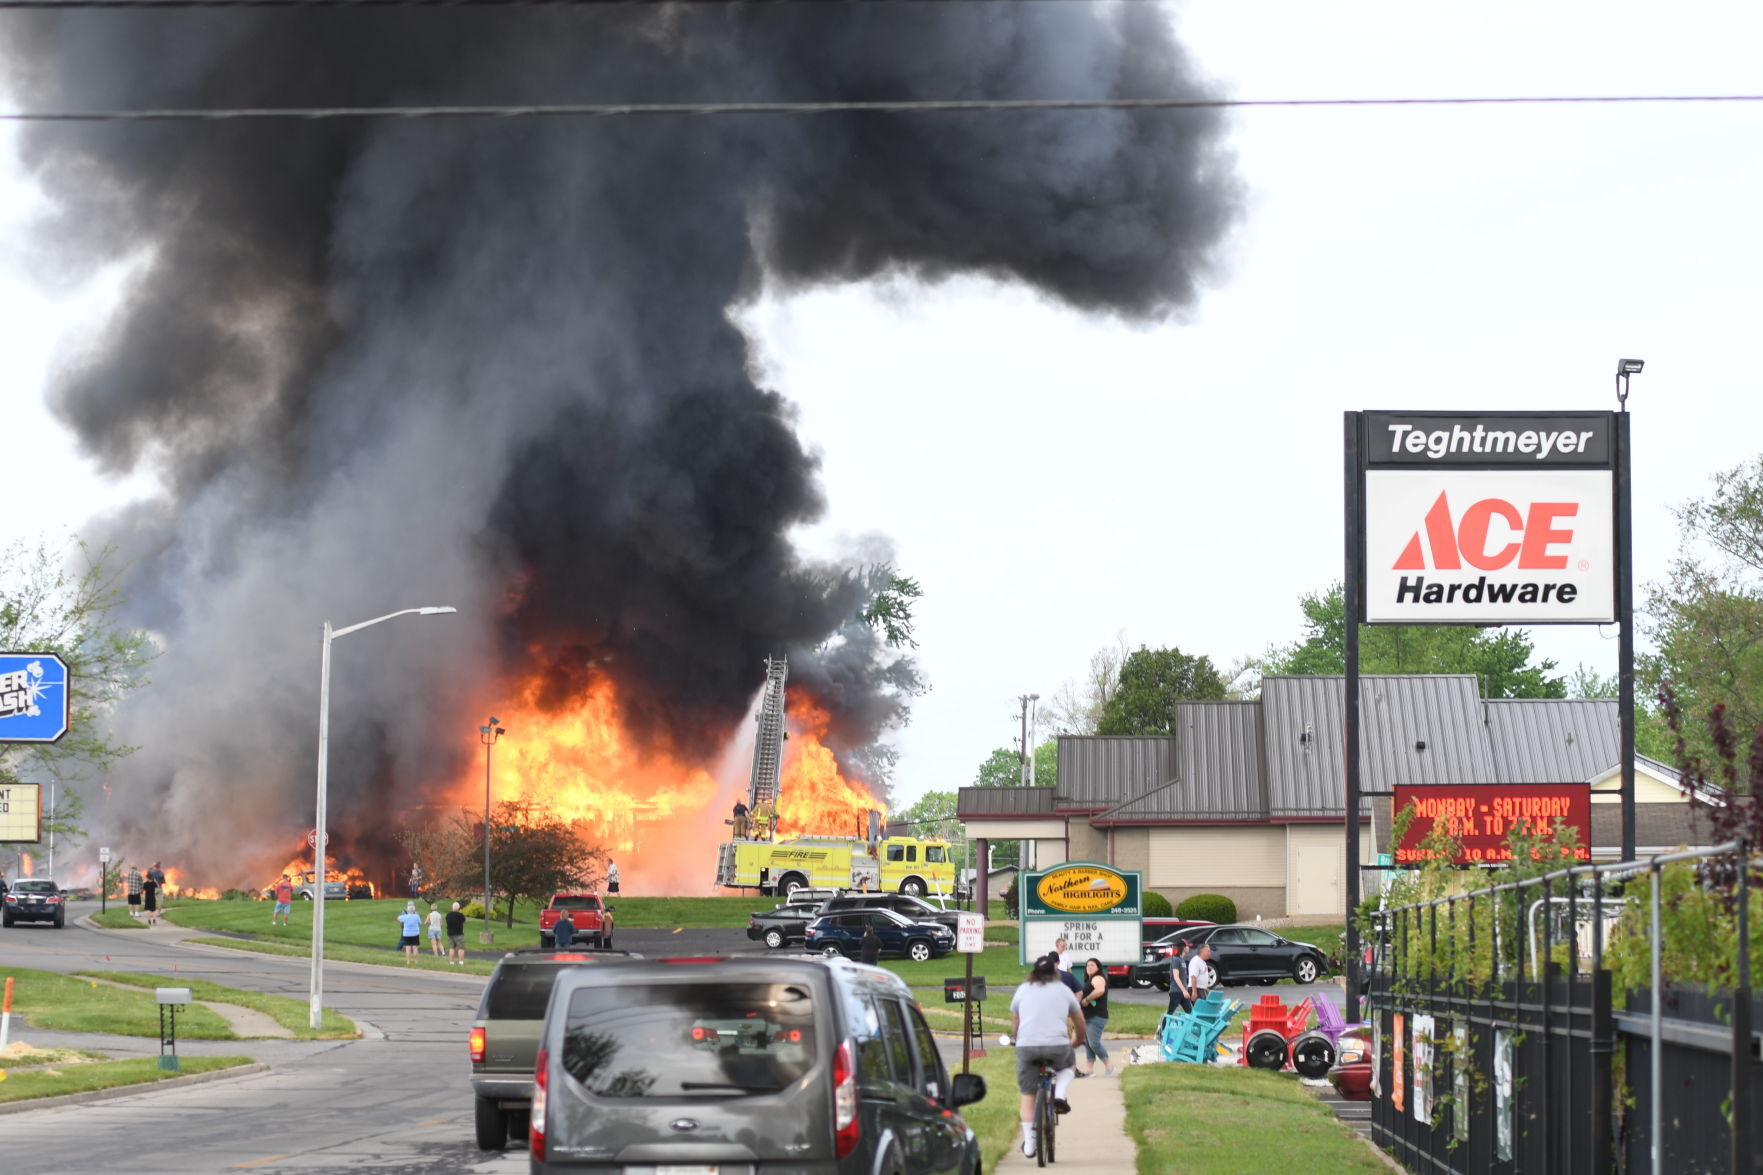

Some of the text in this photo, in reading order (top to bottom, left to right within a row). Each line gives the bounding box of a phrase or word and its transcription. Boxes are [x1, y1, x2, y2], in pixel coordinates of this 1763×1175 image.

[1388, 424, 1593, 460] Teghtmeyer
[1391, 489, 1580, 571] ACE
[1396, 576, 1578, 604] Hardware
[1415, 797, 1475, 818] MONDAY
[1493, 796, 1570, 817] SATURDAY
[1484, 816, 1504, 836] TO
[1465, 848, 1482, 860] 10
[1043, 876, 1090, 896] Northern
[1063, 890, 1121, 898] HIGHLIGHTS
[959, 927, 982, 935] PARKING
[1064, 921, 1098, 932] SPRING
[1060, 932, 1104, 941] IN FOR A
[1065, 942, 1101, 952] AIRCUT
